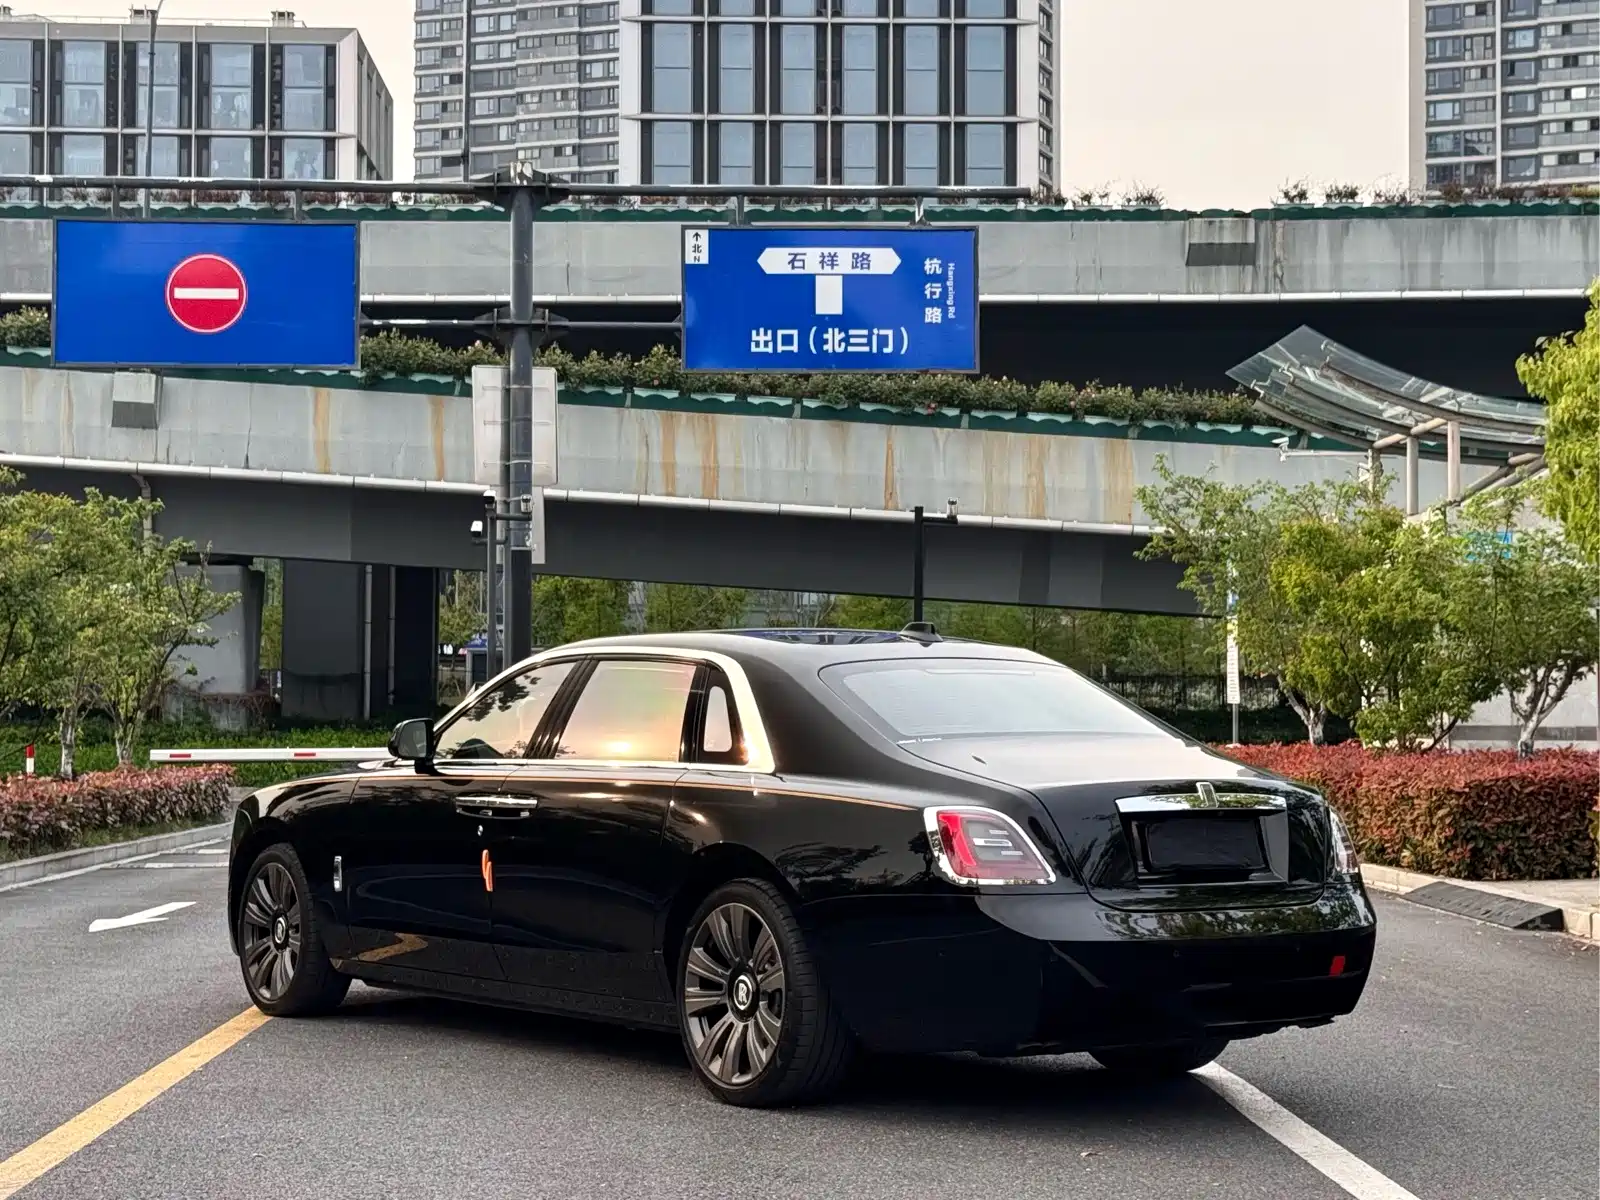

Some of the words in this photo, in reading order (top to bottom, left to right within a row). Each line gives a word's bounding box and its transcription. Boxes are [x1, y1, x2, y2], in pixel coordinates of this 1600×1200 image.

[692, 243, 702, 253] 北
[787, 252, 872, 271] 石祥路
[924, 257, 942, 324] 杭行路
[946, 262, 955, 305] Hangxing
[947, 306, 956, 319] Rd
